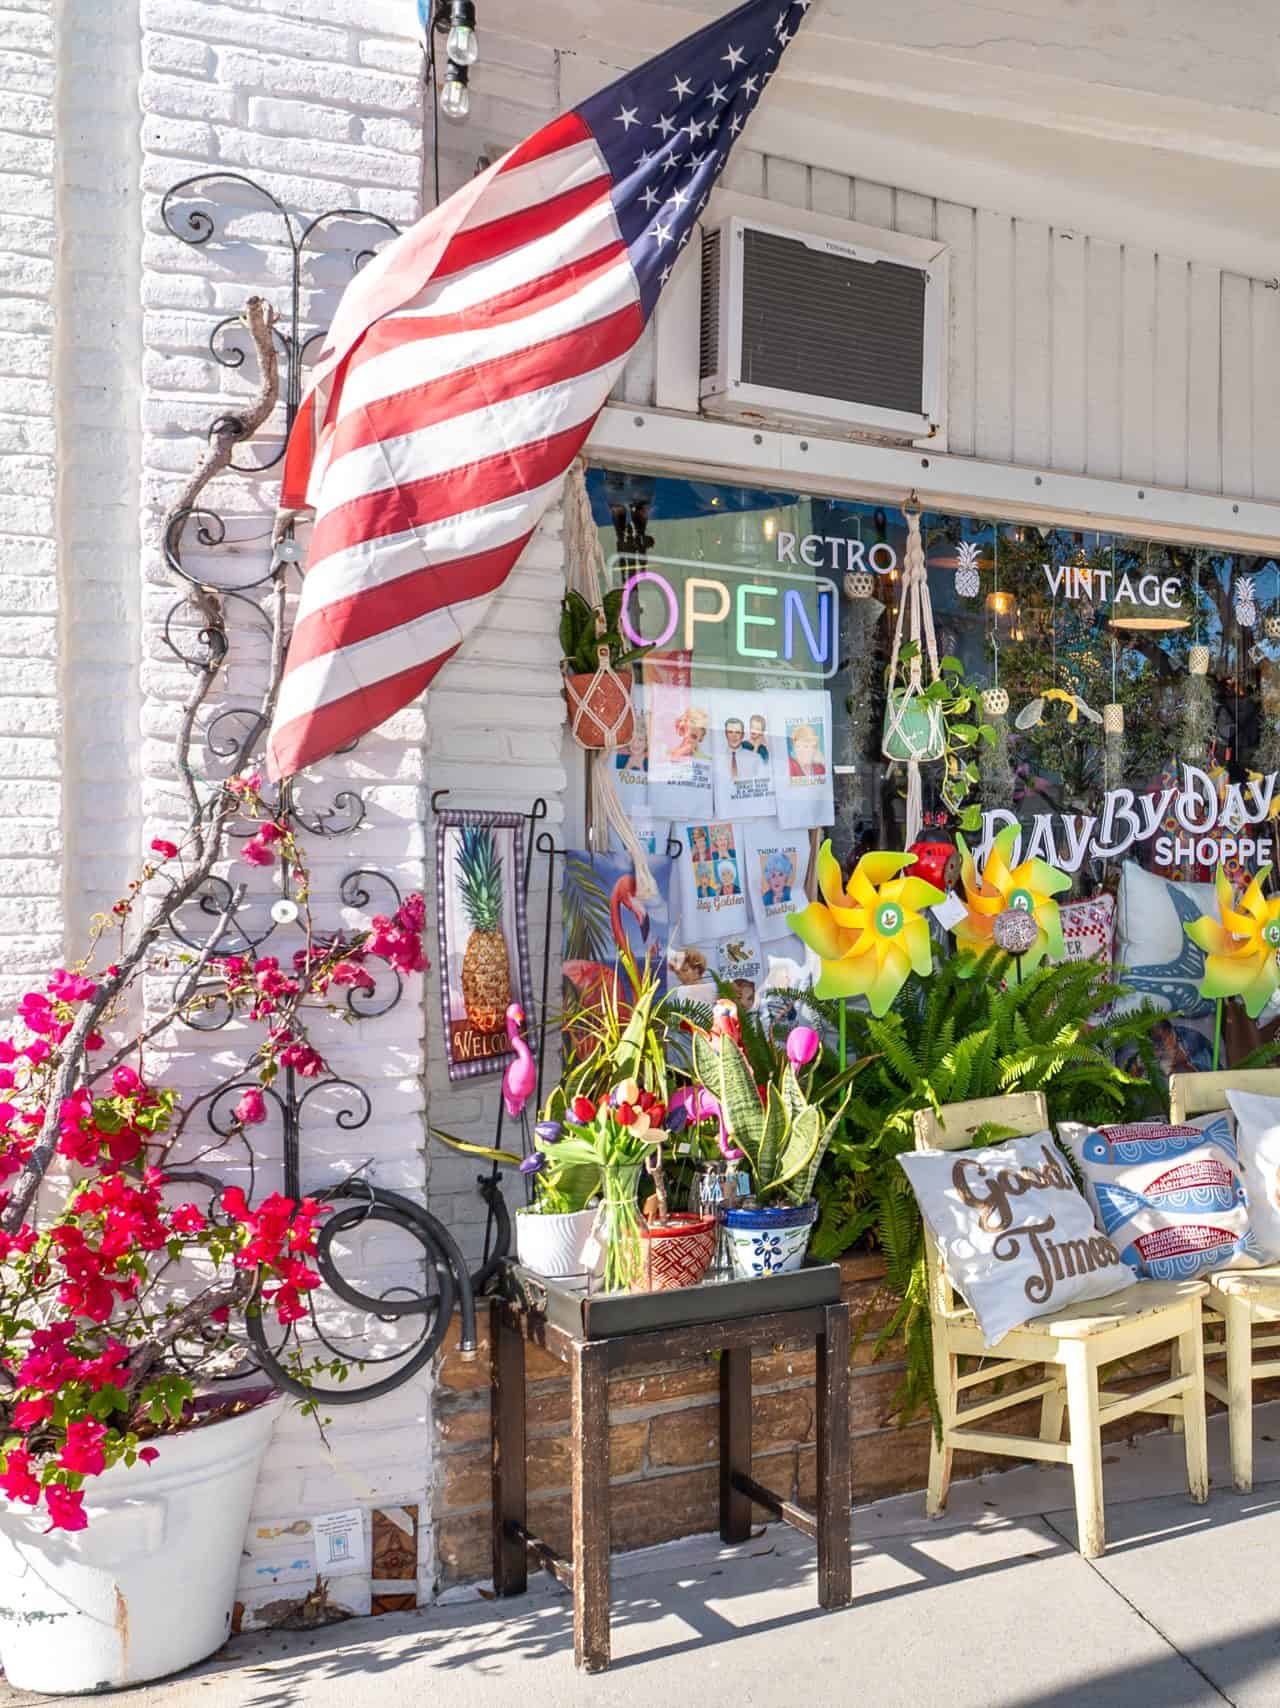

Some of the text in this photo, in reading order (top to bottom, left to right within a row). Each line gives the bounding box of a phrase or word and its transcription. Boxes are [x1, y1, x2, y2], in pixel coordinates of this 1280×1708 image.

[777, 531, 897, 575] RETRO
[1042, 564, 1182, 609] VINTAGE
[620, 571, 829, 664] OPEN
[1174, 763, 1277, 833] DAY
[1155, 838, 1273, 867] SHOPPE
[454, 1030, 508, 1057] WELCO
[952, 1144, 1073, 1233] Good
[993, 1215, 1120, 1304] Times
